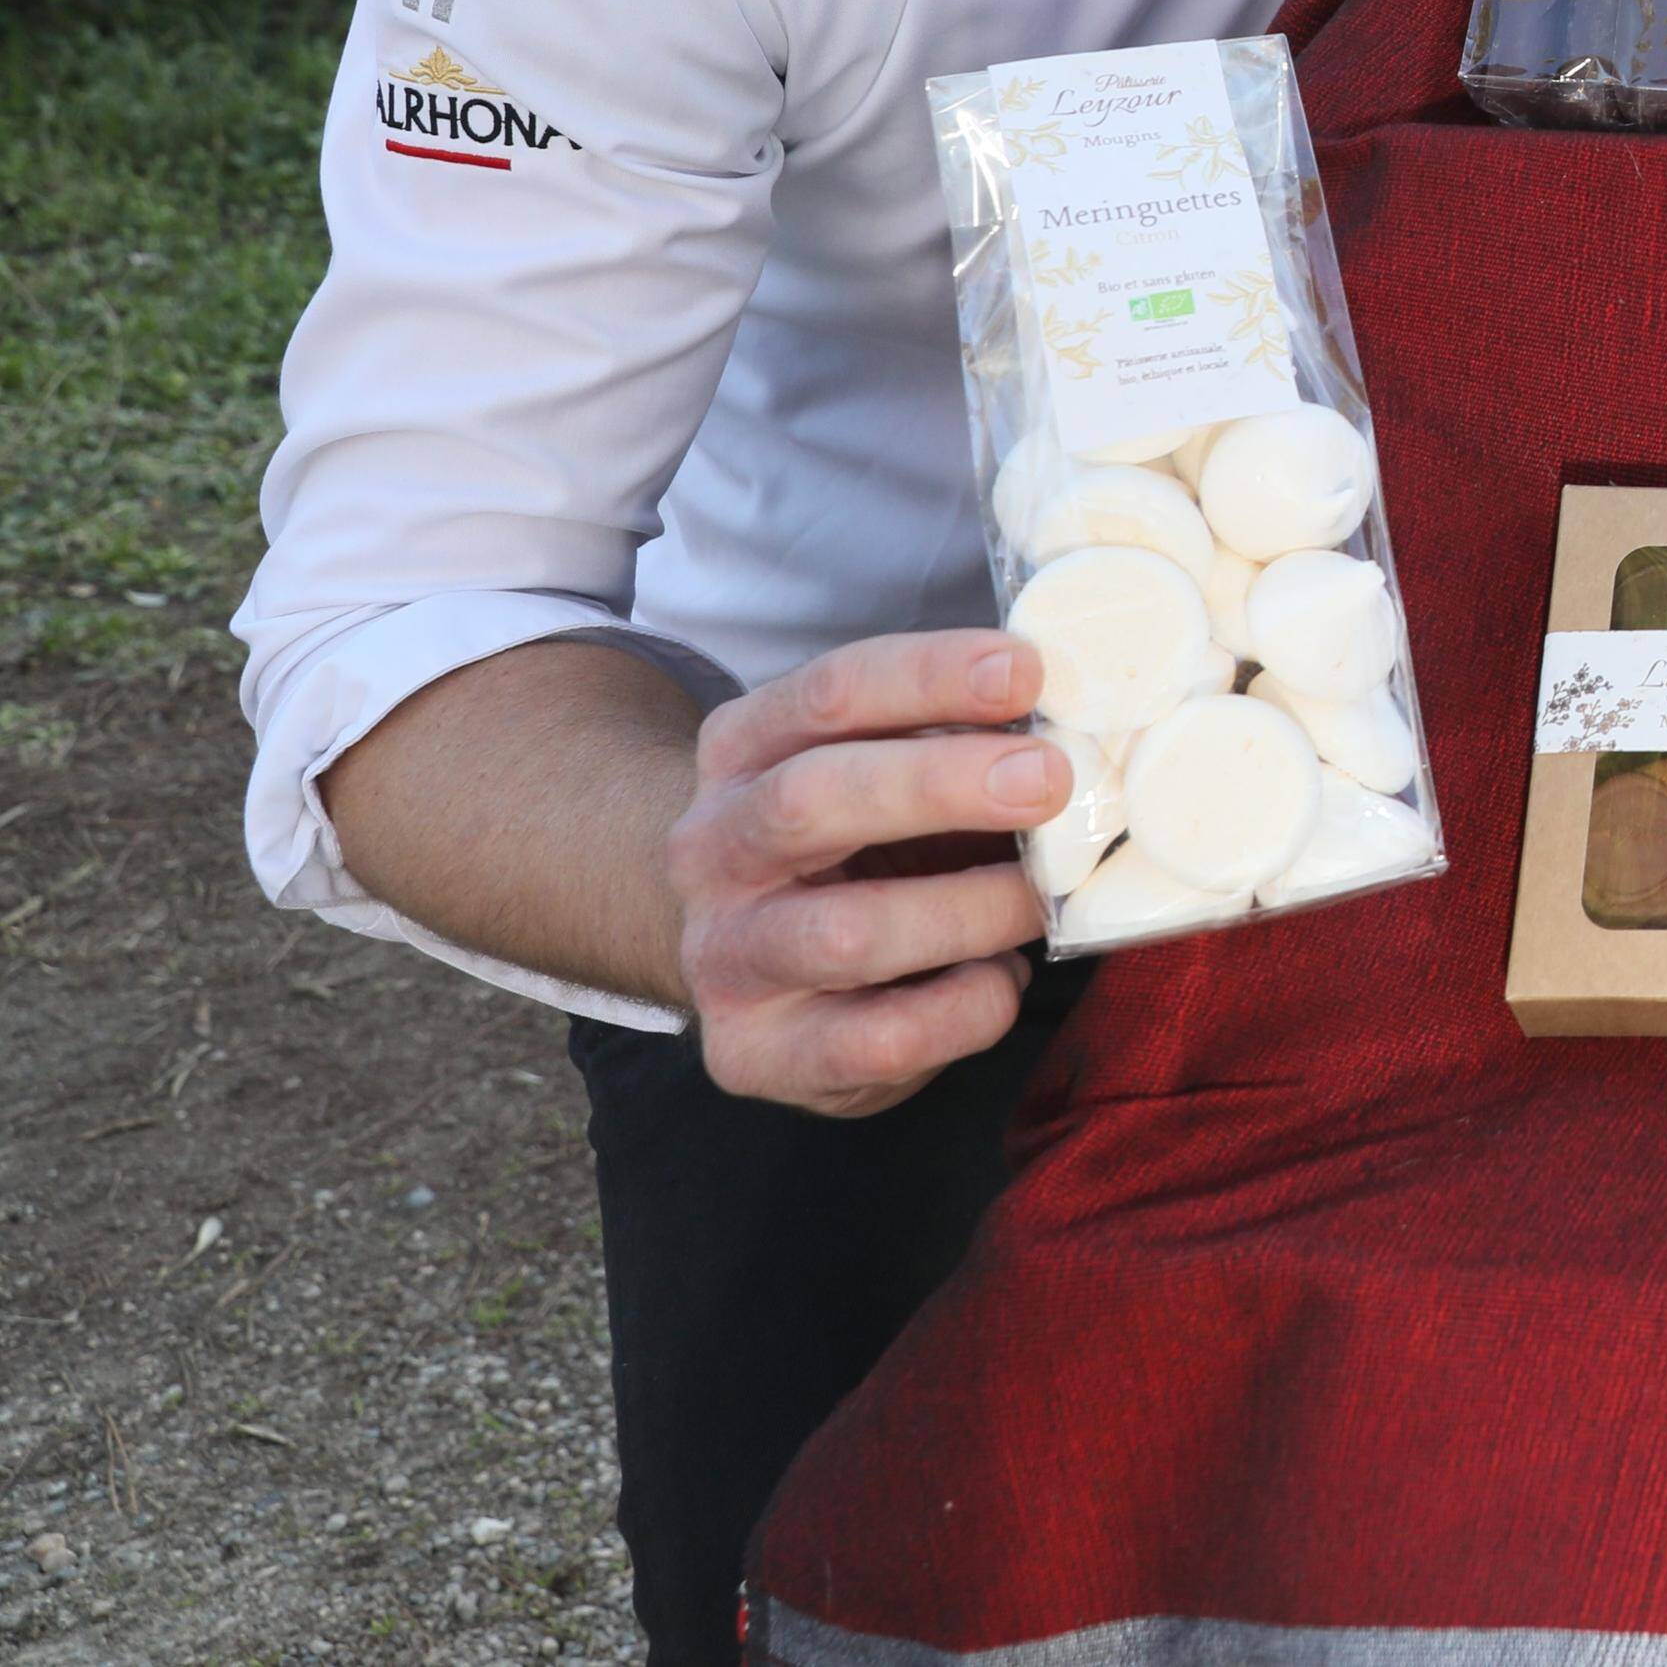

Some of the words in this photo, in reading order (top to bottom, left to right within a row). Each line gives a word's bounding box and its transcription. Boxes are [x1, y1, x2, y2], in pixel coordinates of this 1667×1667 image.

[1095, 74, 1166, 92] Pâtisserie
[1049, 89, 1182, 127] Leyzour
[1083, 131, 1162, 148] Mougins
[1039, 190, 1242, 227] Meringuettes
[1115, 229, 1180, 246] Citron
[1097, 281, 1121, 294] Bio
[1124, 279, 1138, 290] et
[1143, 276, 1171, 287] sans
[1175, 270, 1216, 286] gluten
